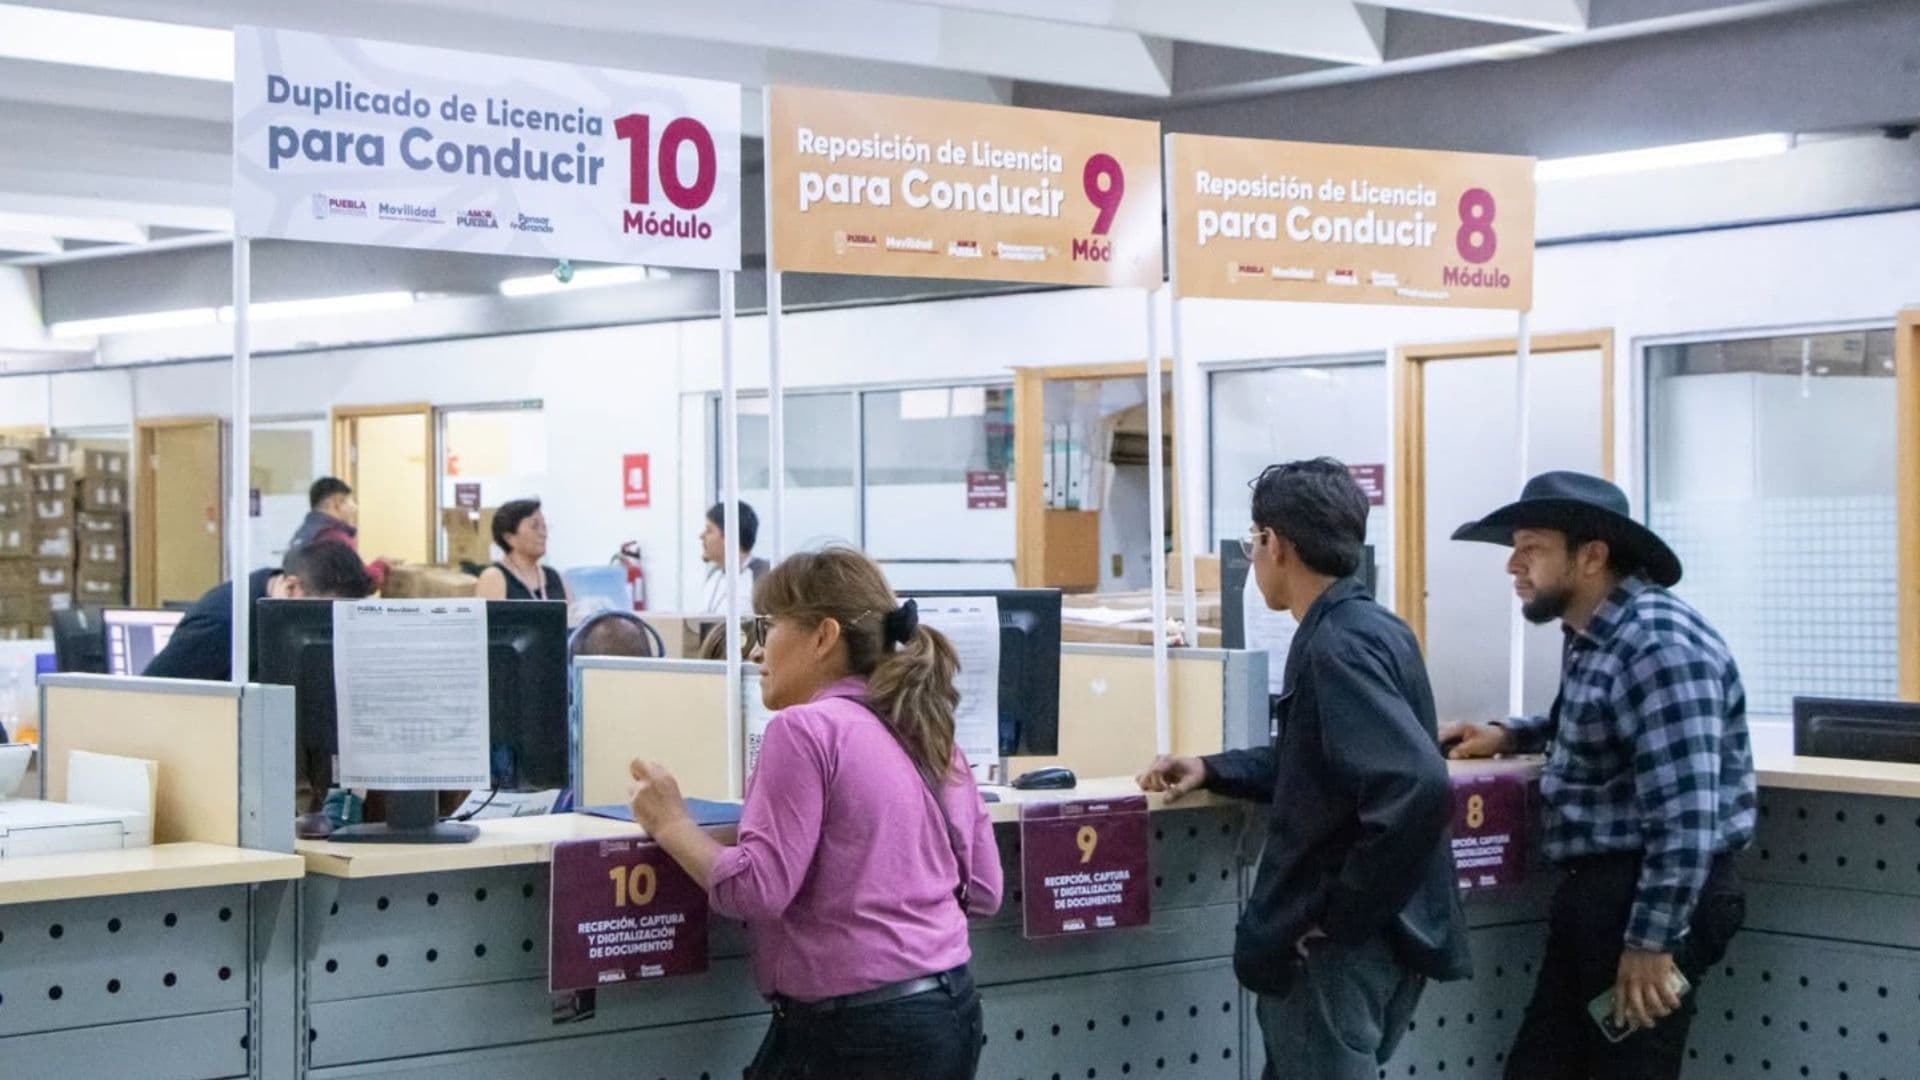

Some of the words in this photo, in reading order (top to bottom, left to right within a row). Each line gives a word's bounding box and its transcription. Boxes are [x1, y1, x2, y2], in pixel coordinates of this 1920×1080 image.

[268, 75, 430, 119] Duplicado
[440, 94, 476, 124] de
[487, 97, 602, 136] Licencia
[269, 124, 385, 169] para
[400, 127, 604, 185] Conducir
[614, 113, 717, 211] 10
[798, 127, 930, 163] Reposición
[937, 139, 965, 165] de
[972, 141, 1063, 173] Licencia
[329, 198, 366, 209] PUEBLA
[800, 169, 891, 212] para
[902, 168, 1065, 217] Conducir
[1083, 153, 1125, 236] 9
[1196, 170, 1313, 201] Reposición
[1318, 180, 1345, 202] de
[1351, 180, 1437, 207] Licencia
[379, 202, 437, 217] Movilidad
[456, 216, 499, 229] PUEBLA
[624, 209, 712, 239] Módulo
[1199, 208, 1277, 245] para
[1286, 206, 1437, 247] Conducir
[1457, 188, 1497, 264] 8
[1072, 238, 1112, 262] Mód
[1443, 265, 1511, 288] Módulo
[1466, 794, 1484, 829] 8
[1076, 825, 1098, 863] 9
[609, 864, 657, 907] 10
[1044, 872, 1092, 887] RECEPCIÓN,
[1093, 870, 1130, 882] CAPTURA
[1053, 888, 1059, 897] Y
[1060, 882, 1123, 897] DIGITALIZACIÓN
[1055, 899, 1066, 909] DE
[1066, 894, 1122, 908] DOCUMENTOS
[578, 915, 637, 934] RECEPCIÓN,
[640, 913, 685, 926] CAPTURA
[588, 935, 596, 945] Y
[597, 927, 675, 945] DIGITALIZACIÓN
[589, 947, 603, 959] DE
[605, 940, 673, 957] DOCUMENTOS
